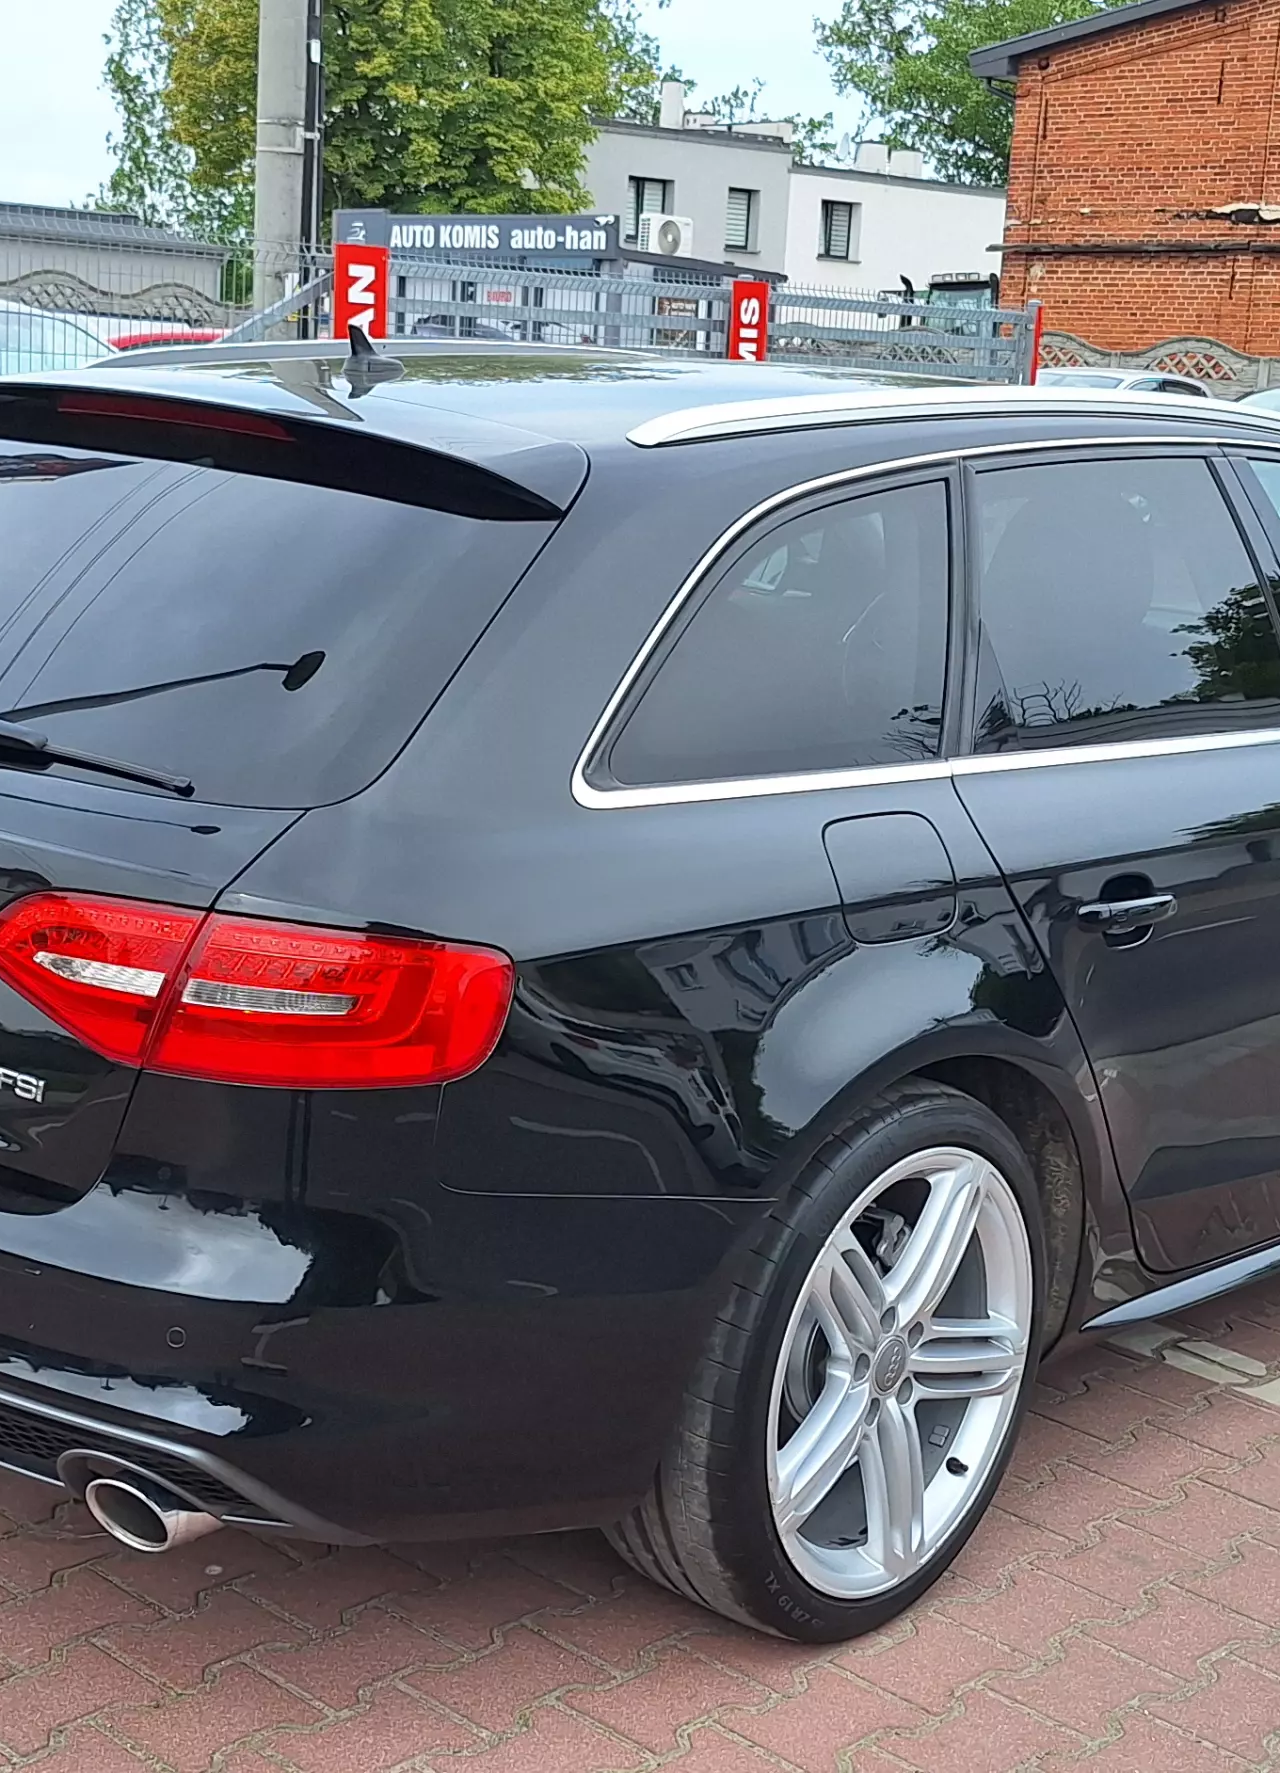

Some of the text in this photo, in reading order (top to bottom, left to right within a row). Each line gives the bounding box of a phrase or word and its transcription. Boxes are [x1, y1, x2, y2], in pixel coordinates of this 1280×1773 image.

[390, 225, 607, 250] AUTO KOMIS auto-han
[347, 263, 376, 339] AN
